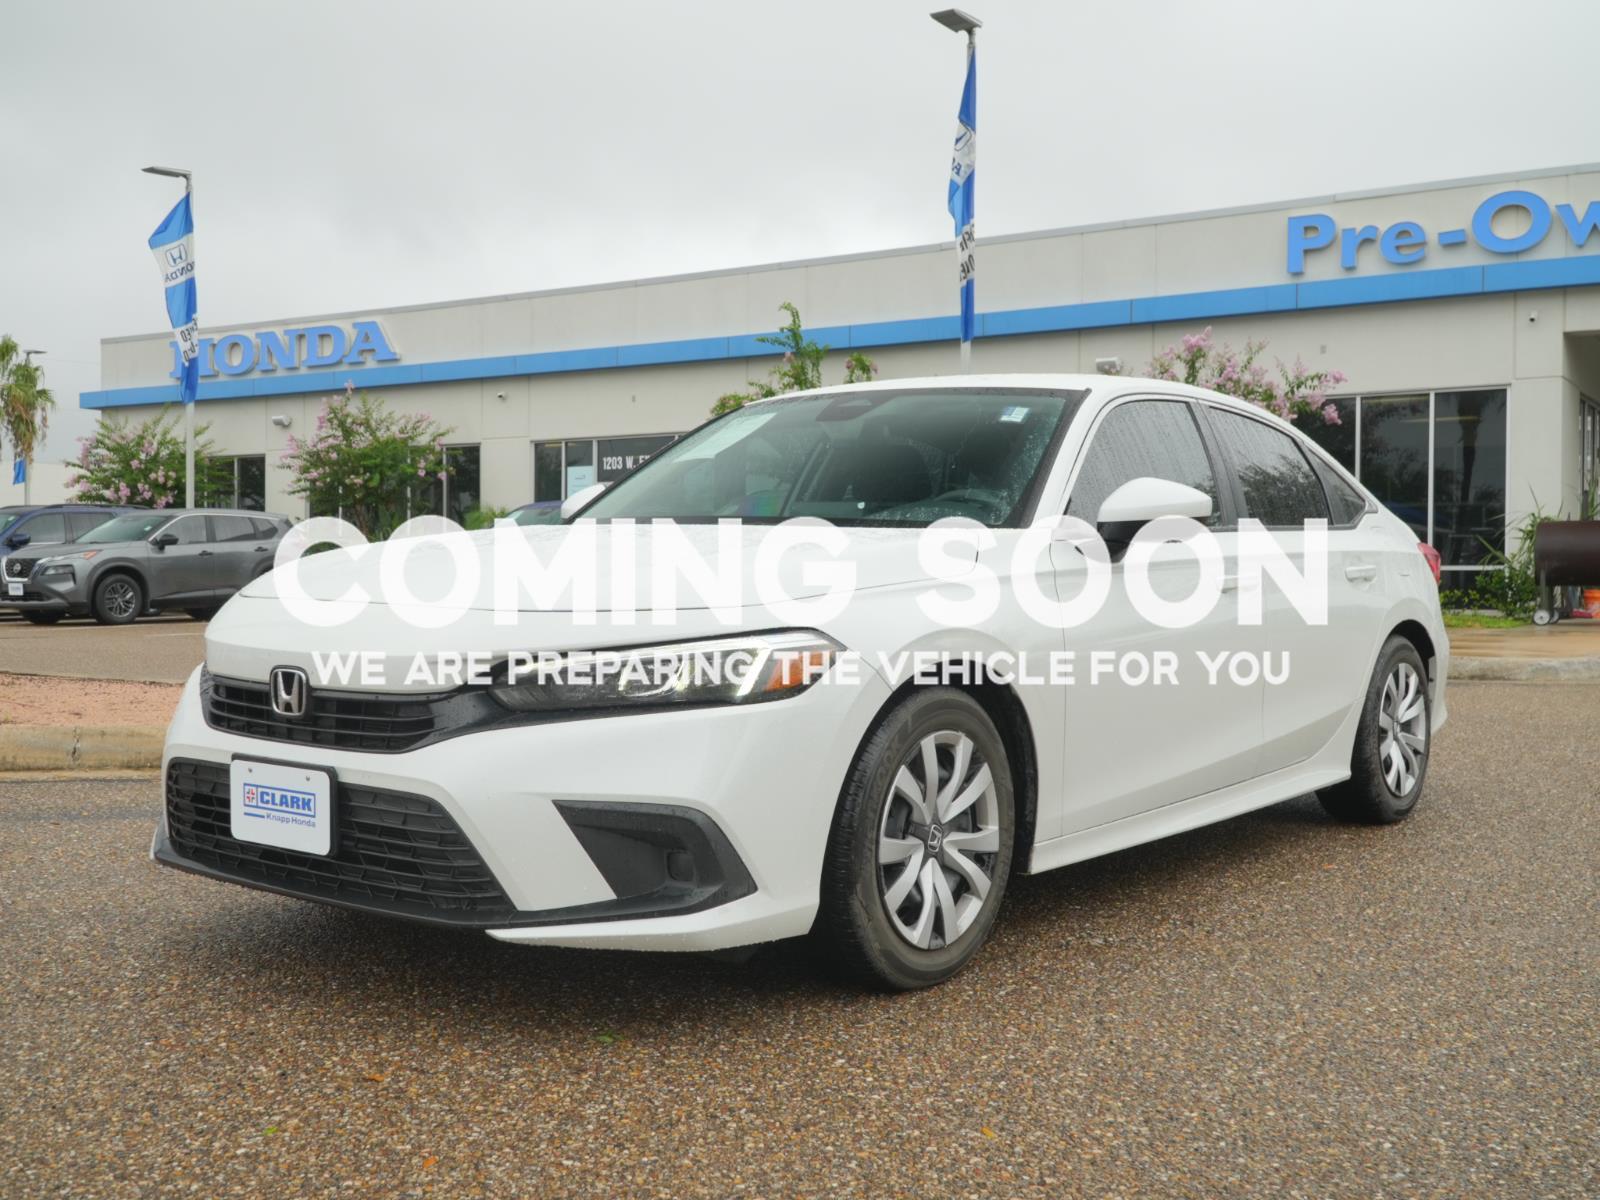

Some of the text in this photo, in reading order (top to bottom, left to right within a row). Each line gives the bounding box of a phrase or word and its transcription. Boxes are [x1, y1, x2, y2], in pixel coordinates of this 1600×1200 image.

[169, 320, 398, 379] HONDA
[603, 457, 623, 470] 1203
[626, 455, 636, 469] W.
[259, 791, 312, 812] CLARK
[266, 812, 316, 827] Knapp Honda
